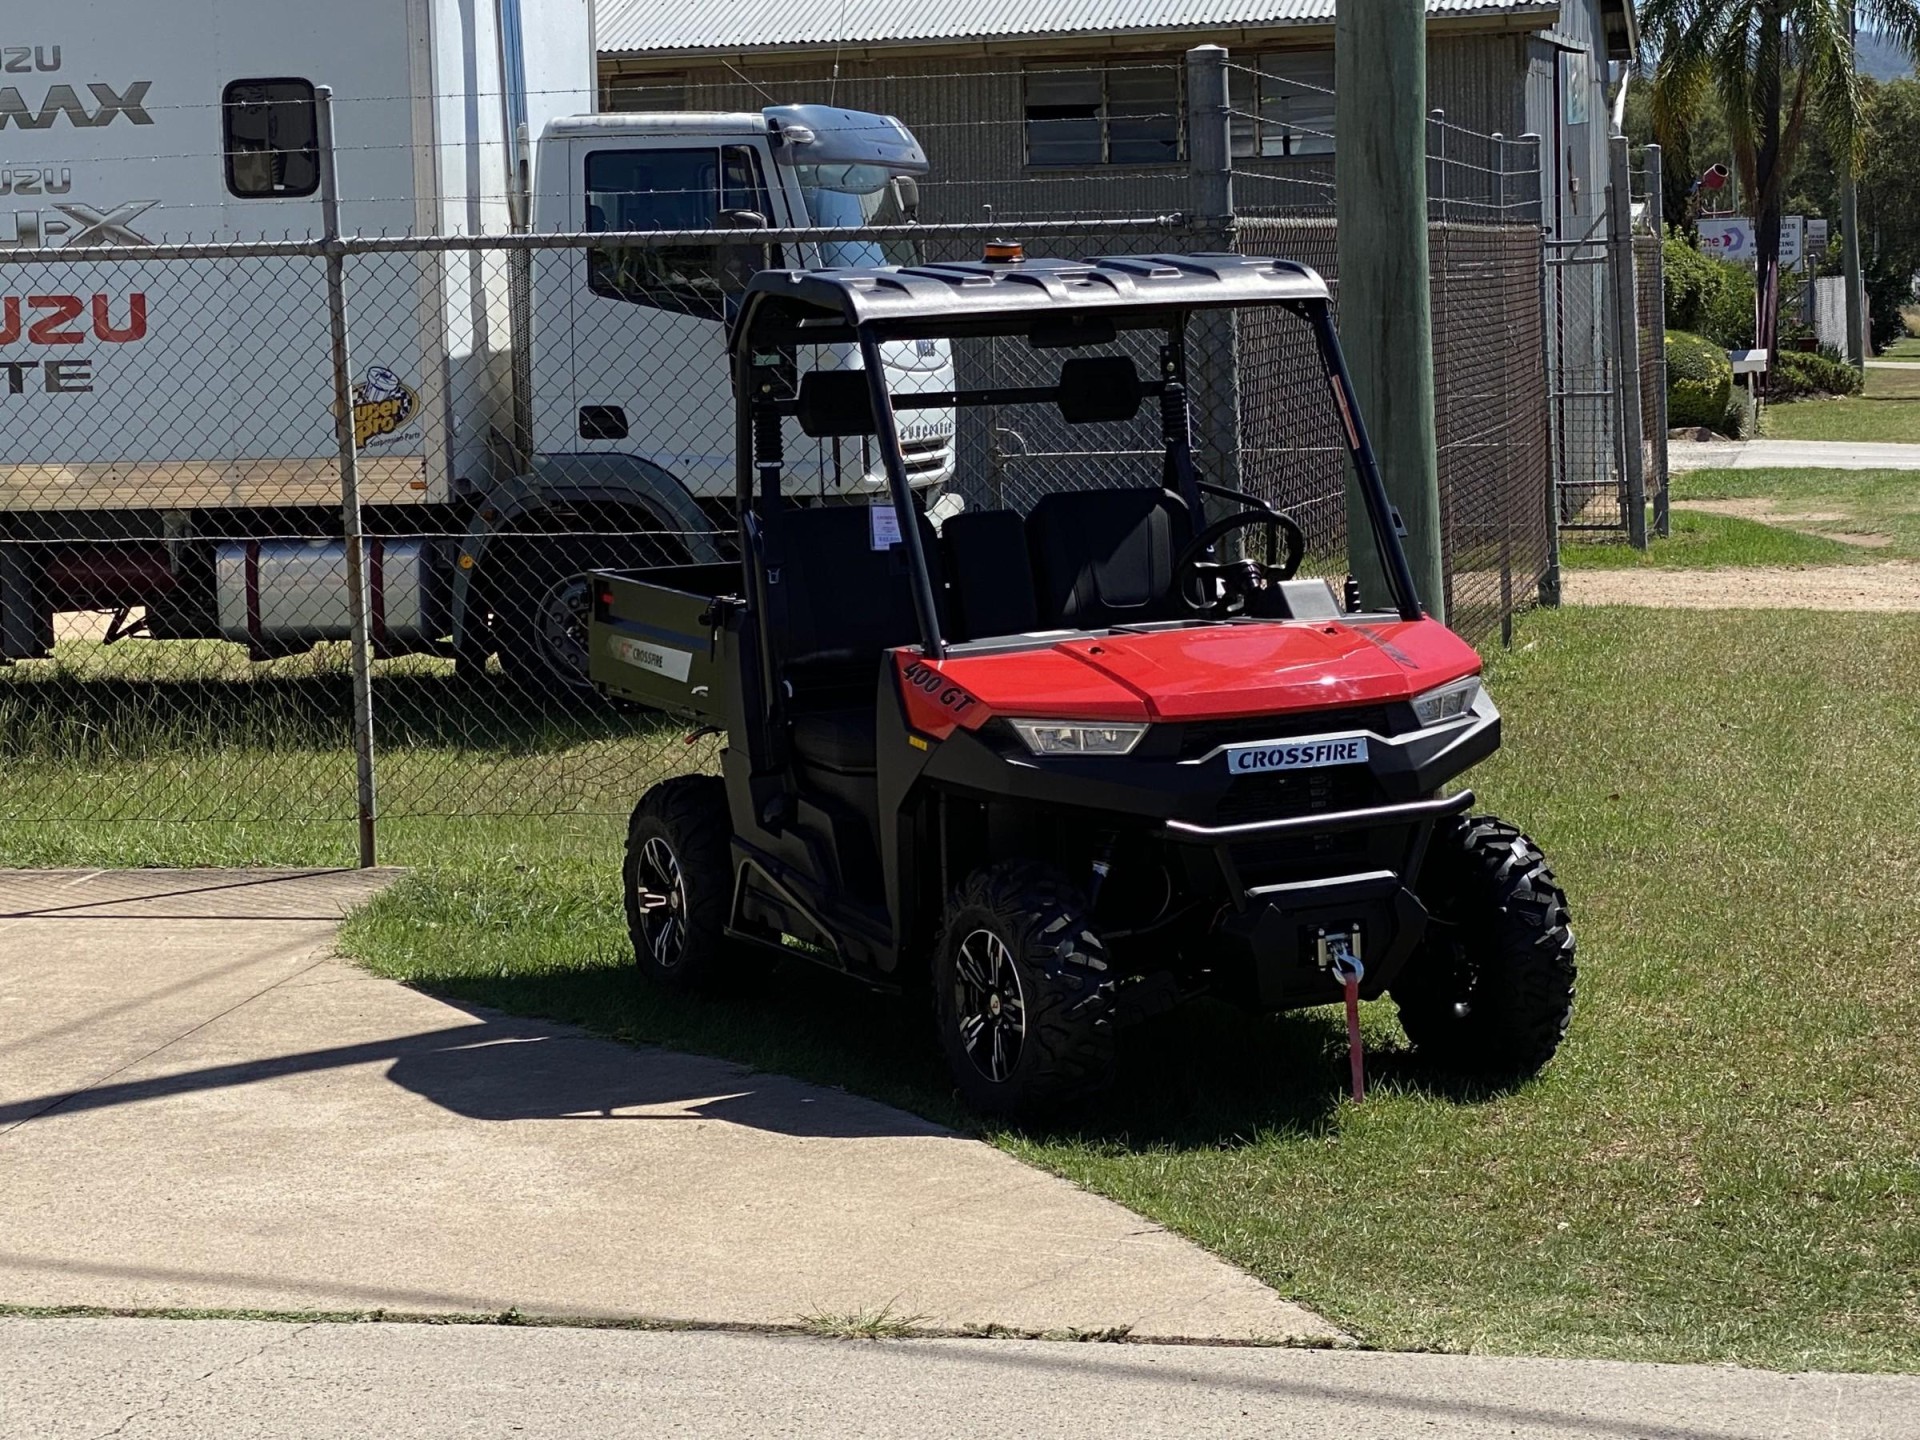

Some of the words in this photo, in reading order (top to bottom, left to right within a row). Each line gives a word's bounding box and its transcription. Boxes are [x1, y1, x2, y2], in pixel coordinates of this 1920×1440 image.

[354, 400, 401, 421] uper
[404, 431, 420, 441] Parts
[632, 647, 664, 669] CROSSFIRE
[902, 662, 943, 693] 400
[940, 687, 977, 712] GT
[1238, 742, 1358, 769] CROSSFIRE
